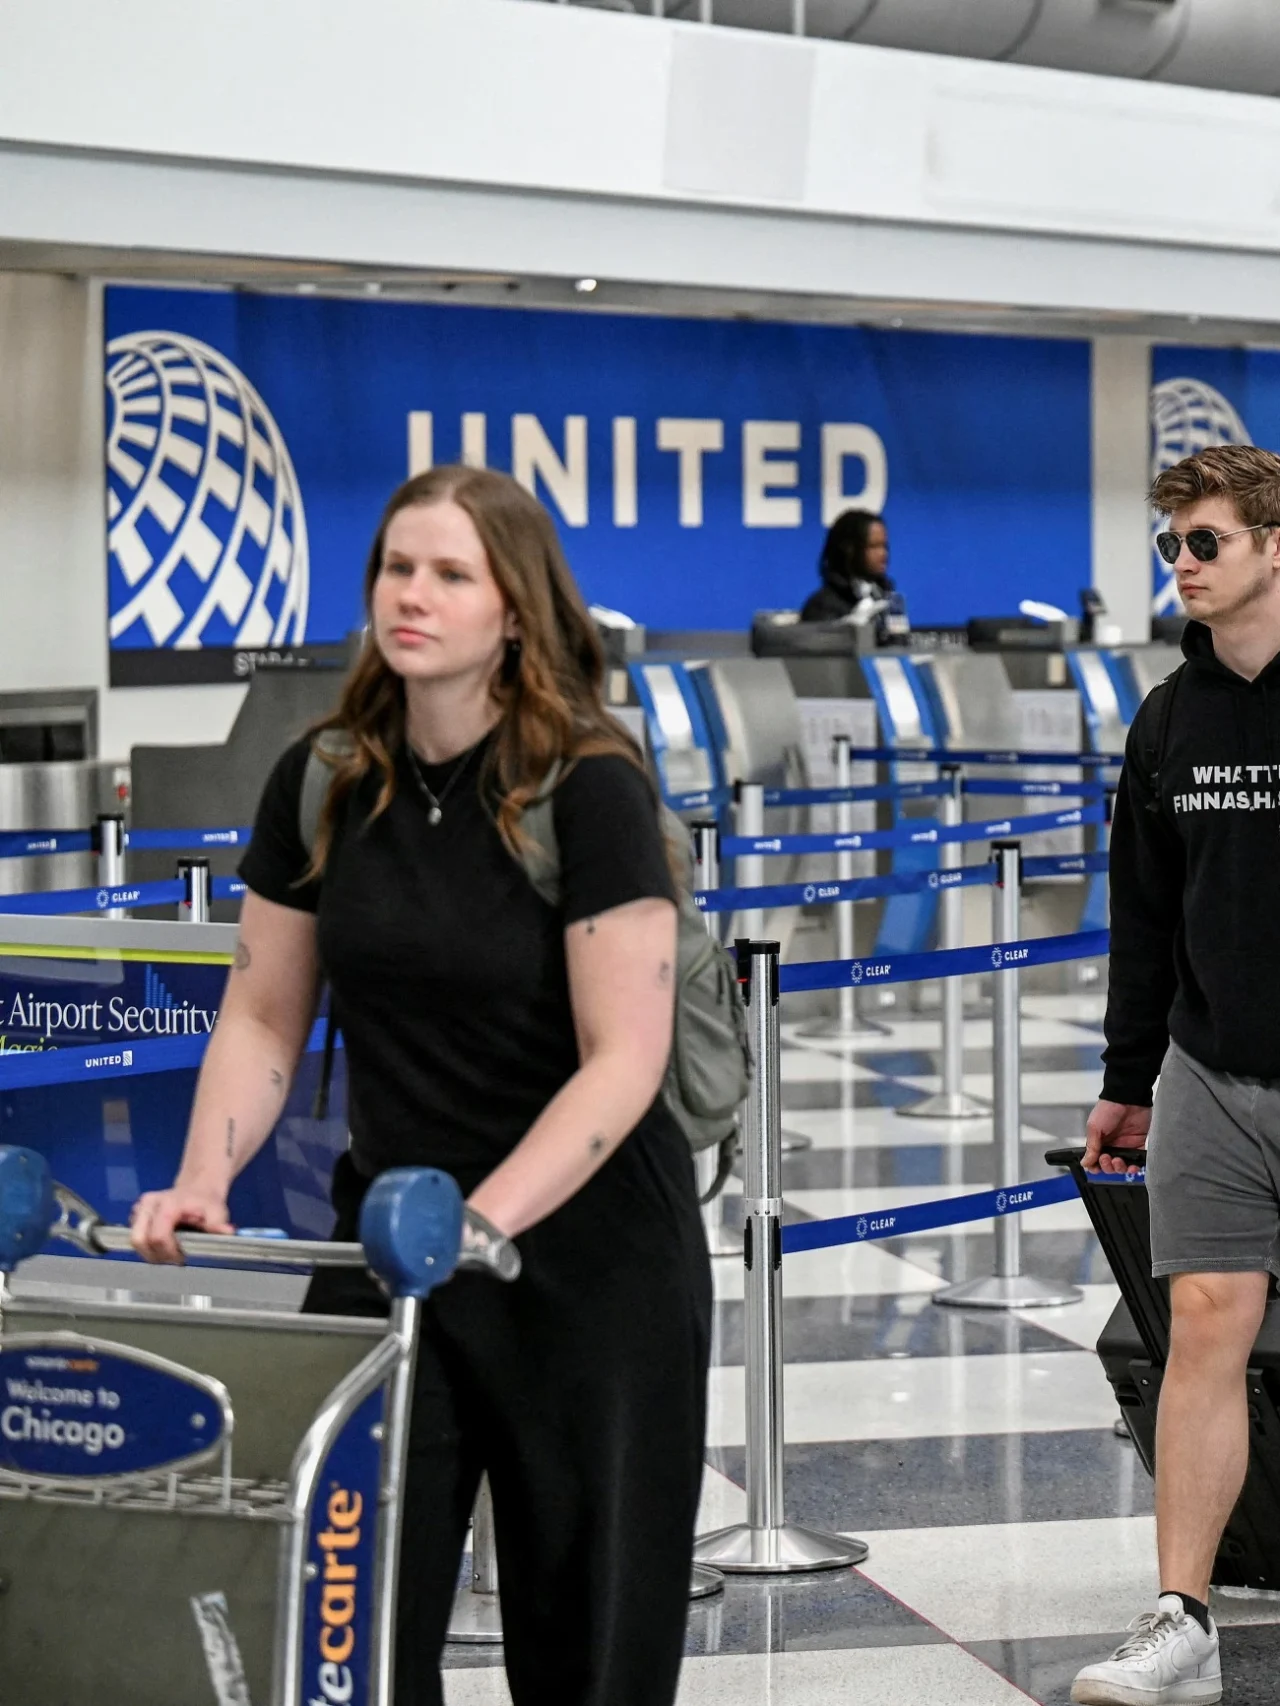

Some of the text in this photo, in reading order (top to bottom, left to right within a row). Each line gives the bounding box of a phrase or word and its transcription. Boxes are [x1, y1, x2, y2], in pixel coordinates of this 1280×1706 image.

[112, 891, 140, 902] CLEAR
[1004, 949, 1028, 961] CLEAR
[866, 965, 891, 977] CLEAR
[8, 992, 103, 1037] Airport
[85, 1055, 121, 1068] UNITED
[1009, 1191, 1033, 1205] CLEAR
[870, 1217, 896, 1231] CLEAR
[6, 1379, 120, 1409] Welcome to
[1, 1406, 125, 1455] Chicago
